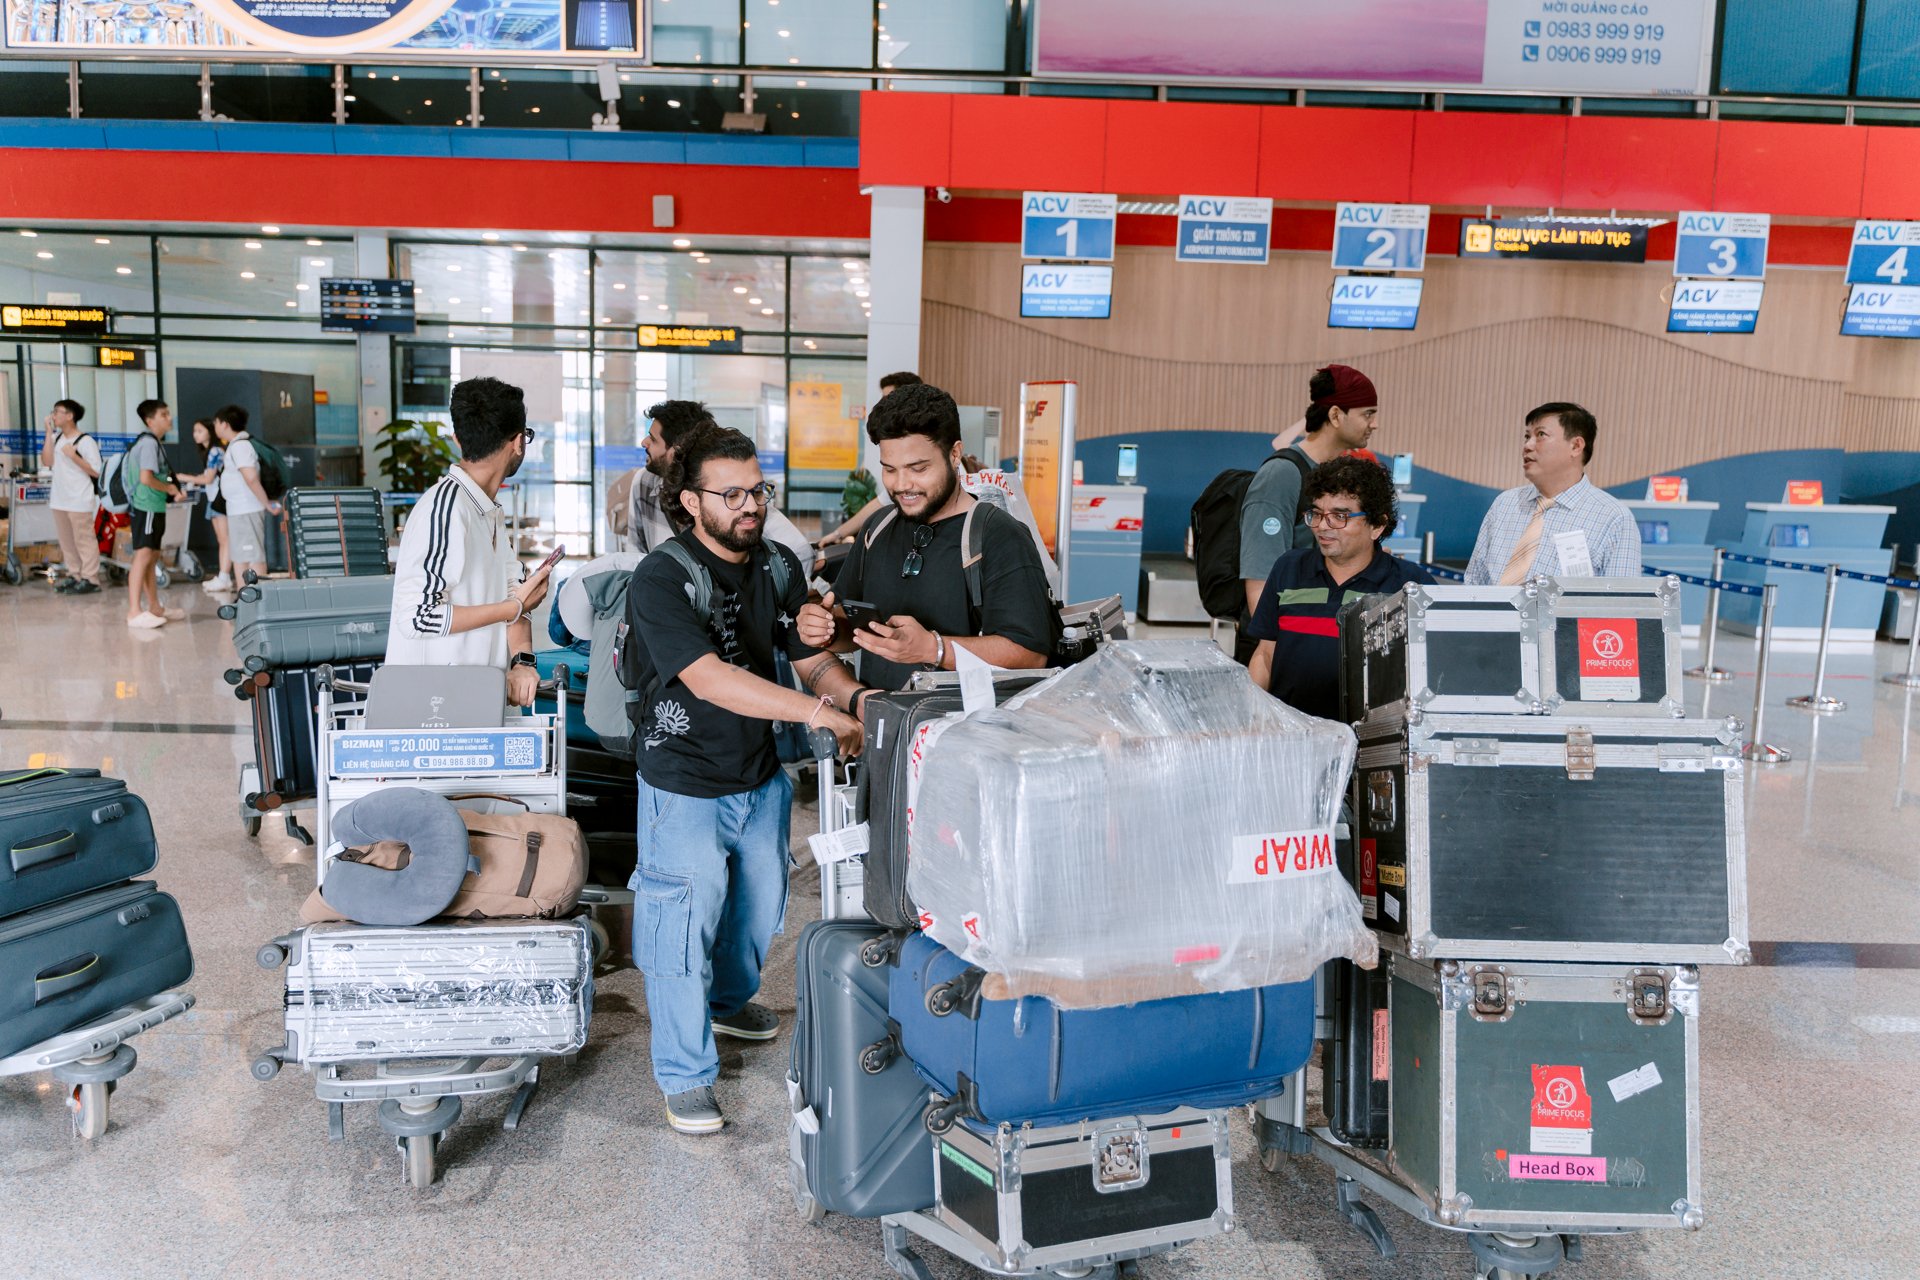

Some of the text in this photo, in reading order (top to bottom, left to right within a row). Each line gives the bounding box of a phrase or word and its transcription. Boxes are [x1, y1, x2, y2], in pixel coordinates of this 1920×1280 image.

[1571, 1, 1617, 14] QUẢNG
[1621, 2, 1648, 15] CÁO
[1547, 21, 1664, 40] 0983 999 919
[1547, 46, 1661, 65] 0906 999 919
[1026, 197, 1069, 212] ACV
[1184, 200, 1226, 216] ACV
[1341, 207, 1382, 222] ACV
[1682, 216, 1725, 232] ACV
[1056, 219, 1078, 256] 1
[1495, 228, 1521, 241] KHU
[1522, 229, 1549, 245] VỰC
[1551, 228, 1577, 244] LÀM
[1606, 232, 1631, 248] TỤC
[1858, 226, 1901, 240] ACV
[1363, 229, 1396, 267] 2
[1707, 238, 1737, 276] 3
[1876, 246, 1908, 283] 4
[1026, 274, 1067, 287] ACV
[1336, 284, 1378, 298] ACV
[1677, 289, 1719, 302] ACV
[1852, 293, 1893, 306] ACV
[52, 310, 79, 320] TRONG
[342, 740, 383, 748] BIZMAN
[401, 739, 440, 752] 20.000
[343, 758, 409, 769] LIÊN HỆ QUẢNG CÁO
[433, 758, 488, 766] 094.986.98.98
[1254, 834, 1332, 875] WRAP
[1520, 1161, 1594, 1176] Head Box
